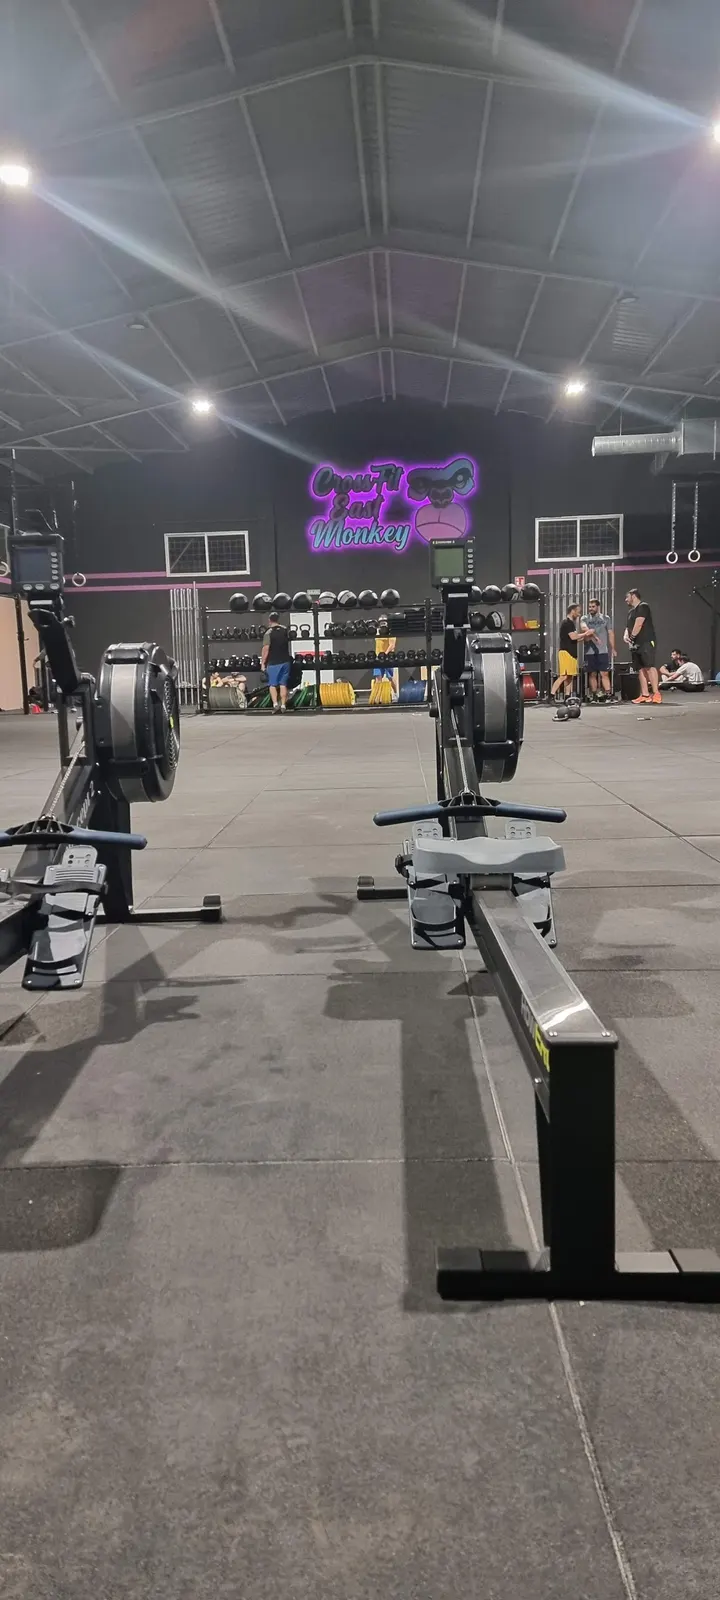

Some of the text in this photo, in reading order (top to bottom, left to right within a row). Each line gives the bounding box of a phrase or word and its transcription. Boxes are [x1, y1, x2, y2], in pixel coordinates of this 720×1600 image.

[312, 463, 404, 496] CrossFit
[330, 493, 385, 520] East
[311, 518, 410, 551] Monkey
